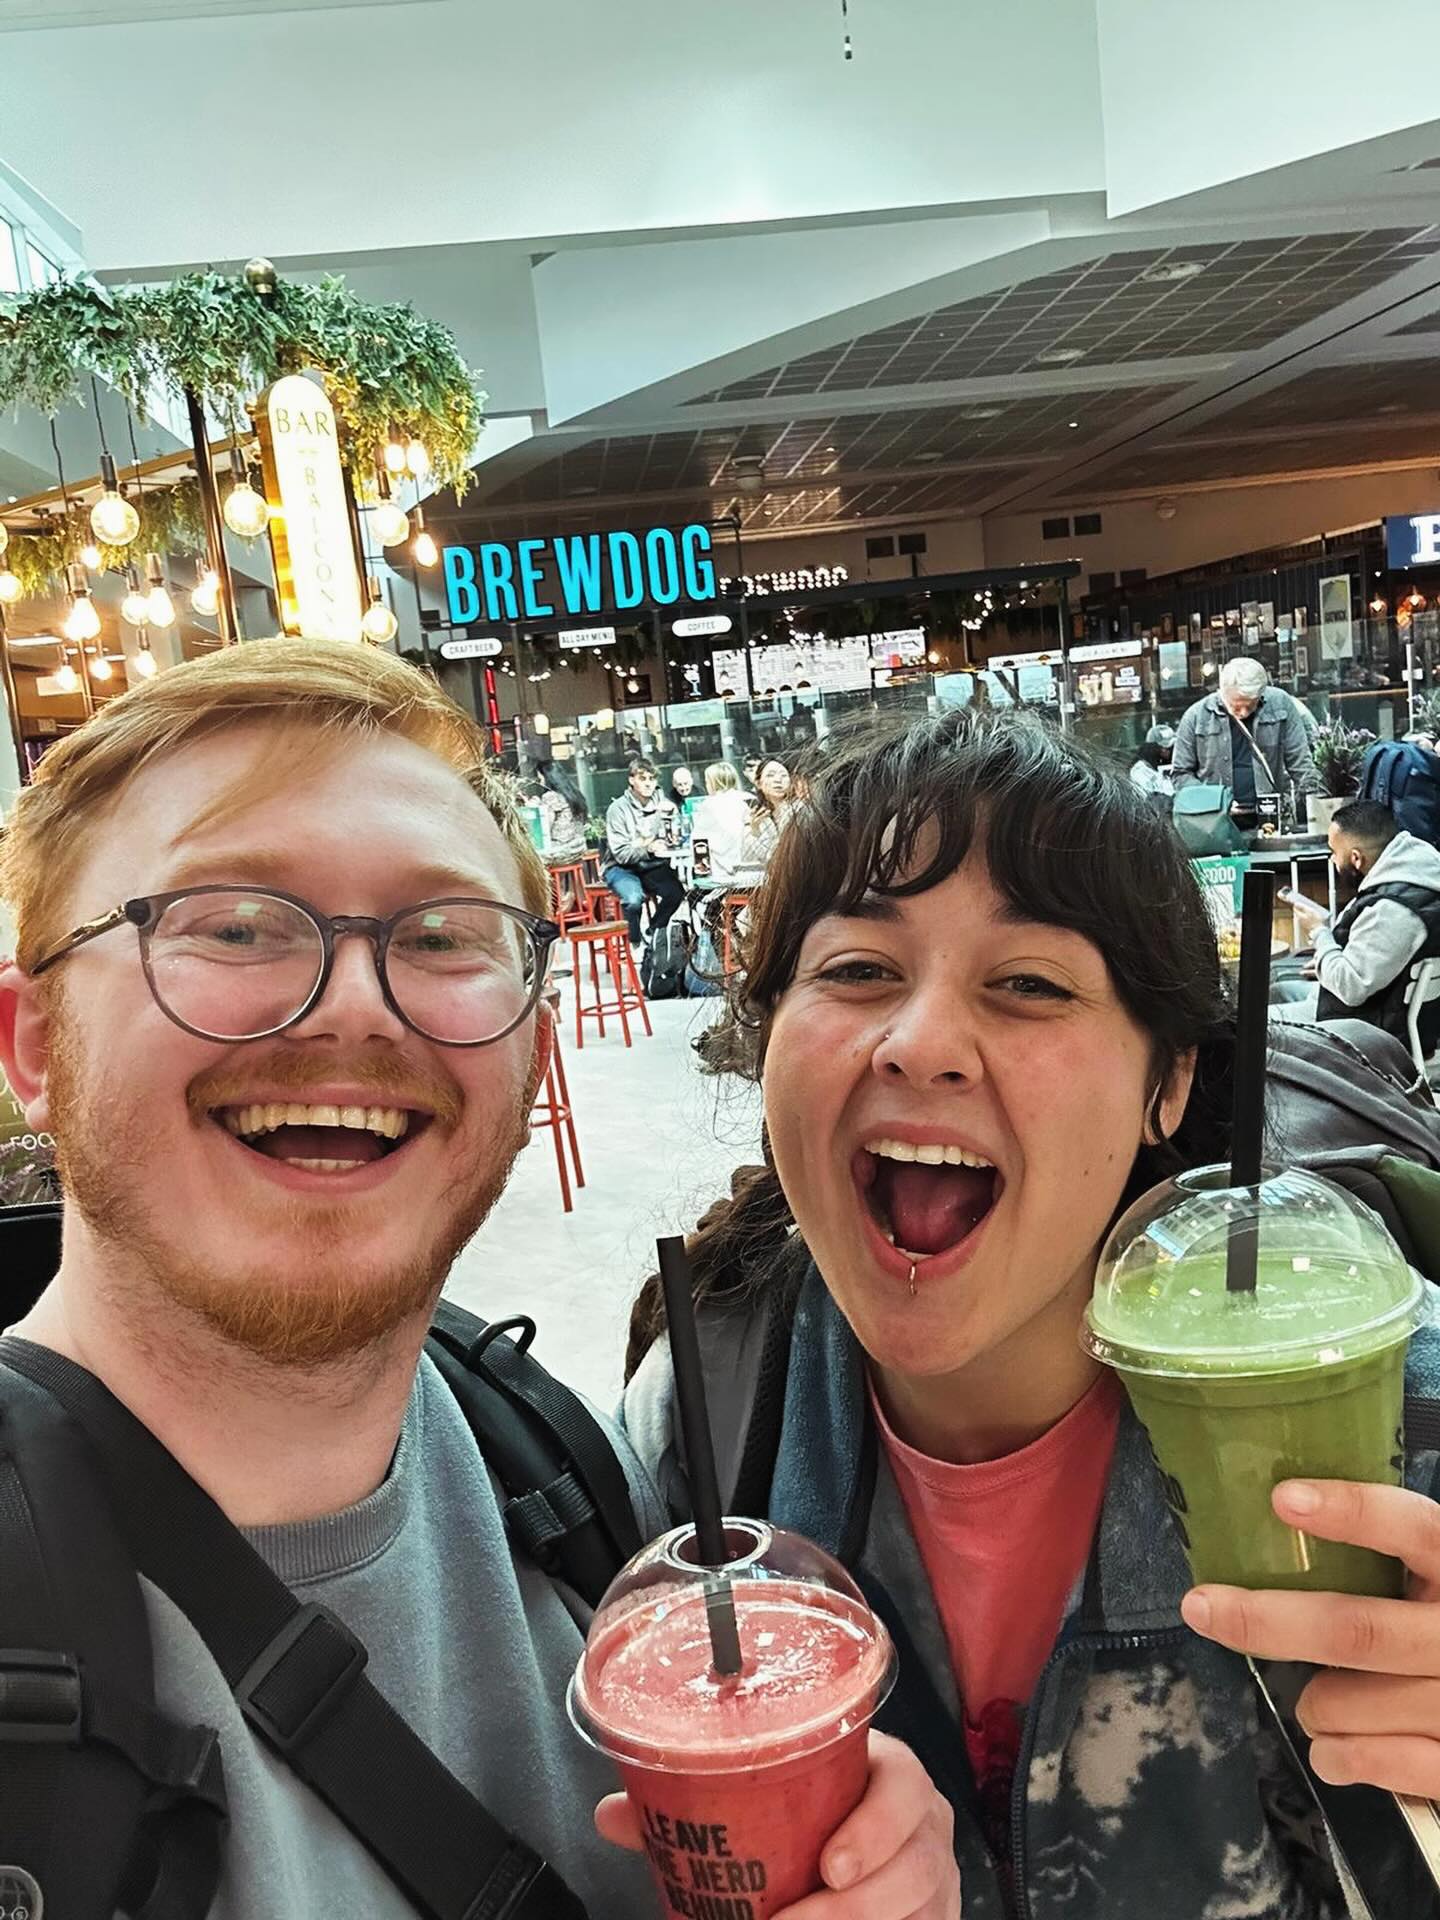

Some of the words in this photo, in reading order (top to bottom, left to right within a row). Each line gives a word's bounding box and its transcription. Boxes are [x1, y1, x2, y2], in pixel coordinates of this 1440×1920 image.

[275, 407, 331, 436] BAR
[303, 466, 336, 624] BALCON
[442, 523, 717, 625] BREWDOG
[561, 634, 574, 644] ALL
[575, 633, 591, 642] DAY
[592, 631, 613, 641] MENU
[687, 621, 716, 632] COFFEE
[449, 644, 473, 655] CRAFT
[474, 642, 494, 652] BEER
[643, 1804, 732, 1857] LEAVE
[688, 1856, 767, 1893] HERD
